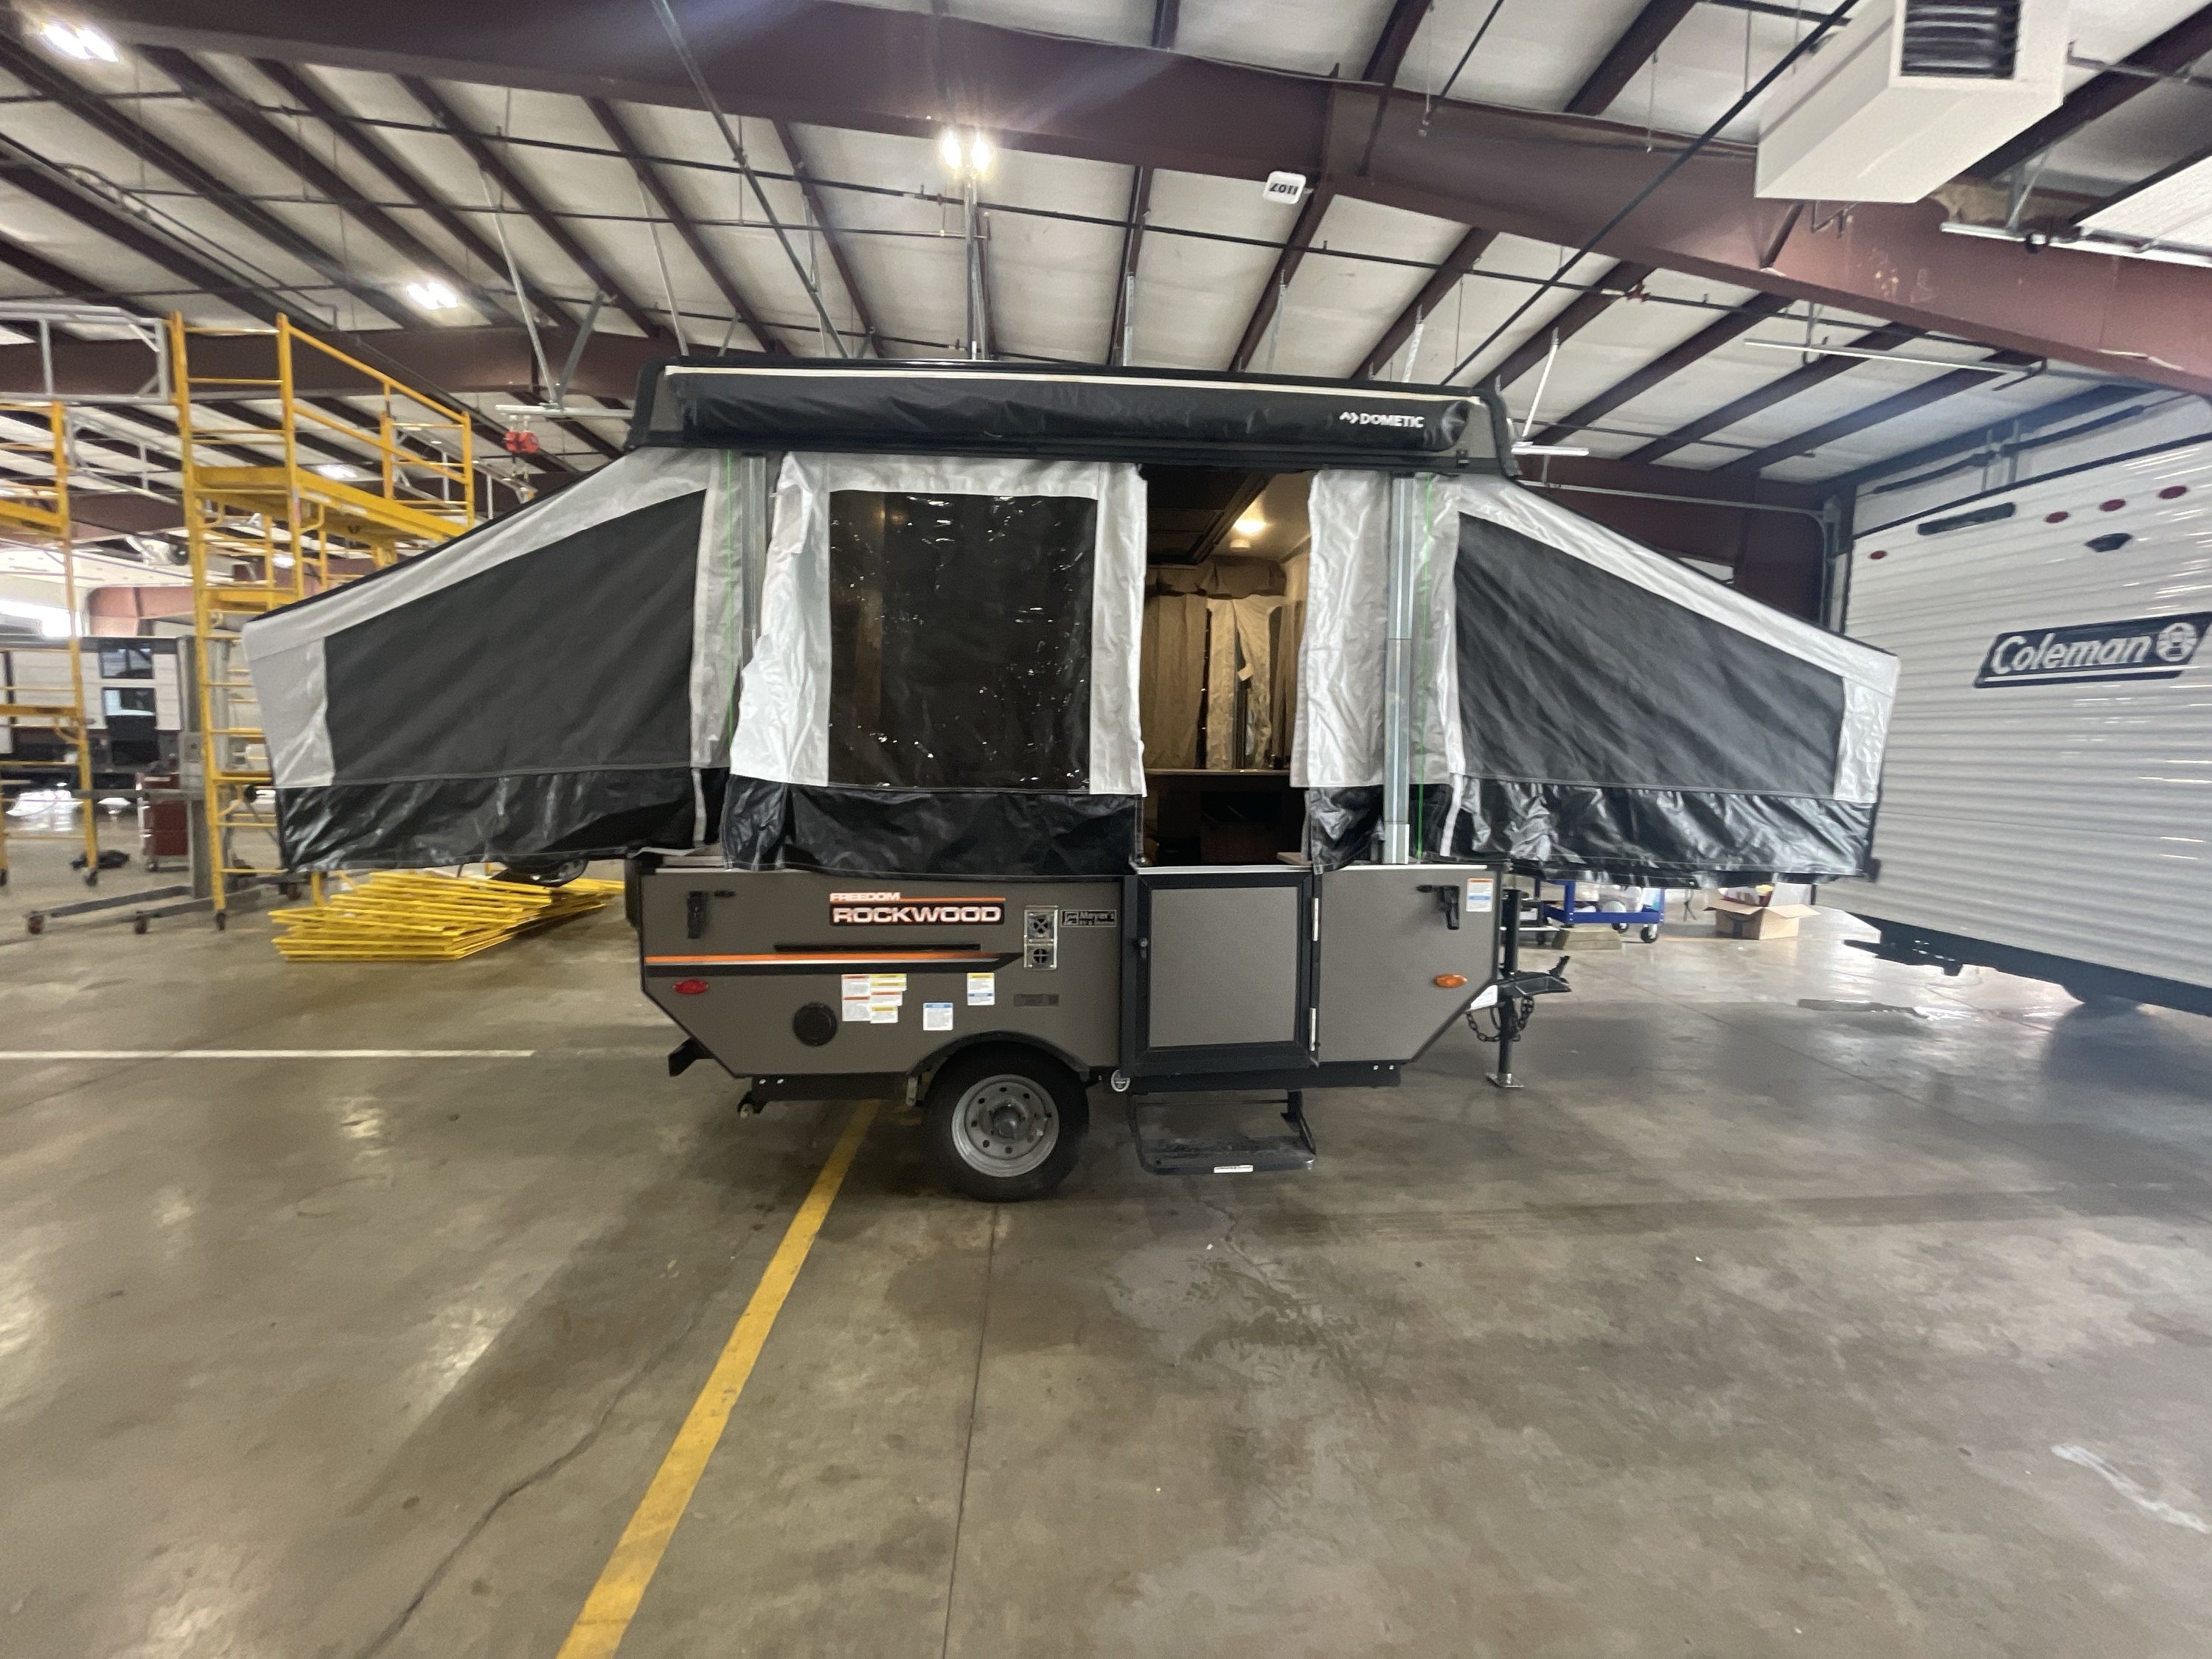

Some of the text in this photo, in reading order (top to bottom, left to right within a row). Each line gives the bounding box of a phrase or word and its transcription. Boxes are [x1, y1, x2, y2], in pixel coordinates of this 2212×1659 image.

[1360, 414, 1425, 428] DOMETIC
[1990, 633, 2153, 675] Coleman
[830, 891, 901, 901] FREEDOM
[832, 906, 1002, 922] ROCKWOOD
